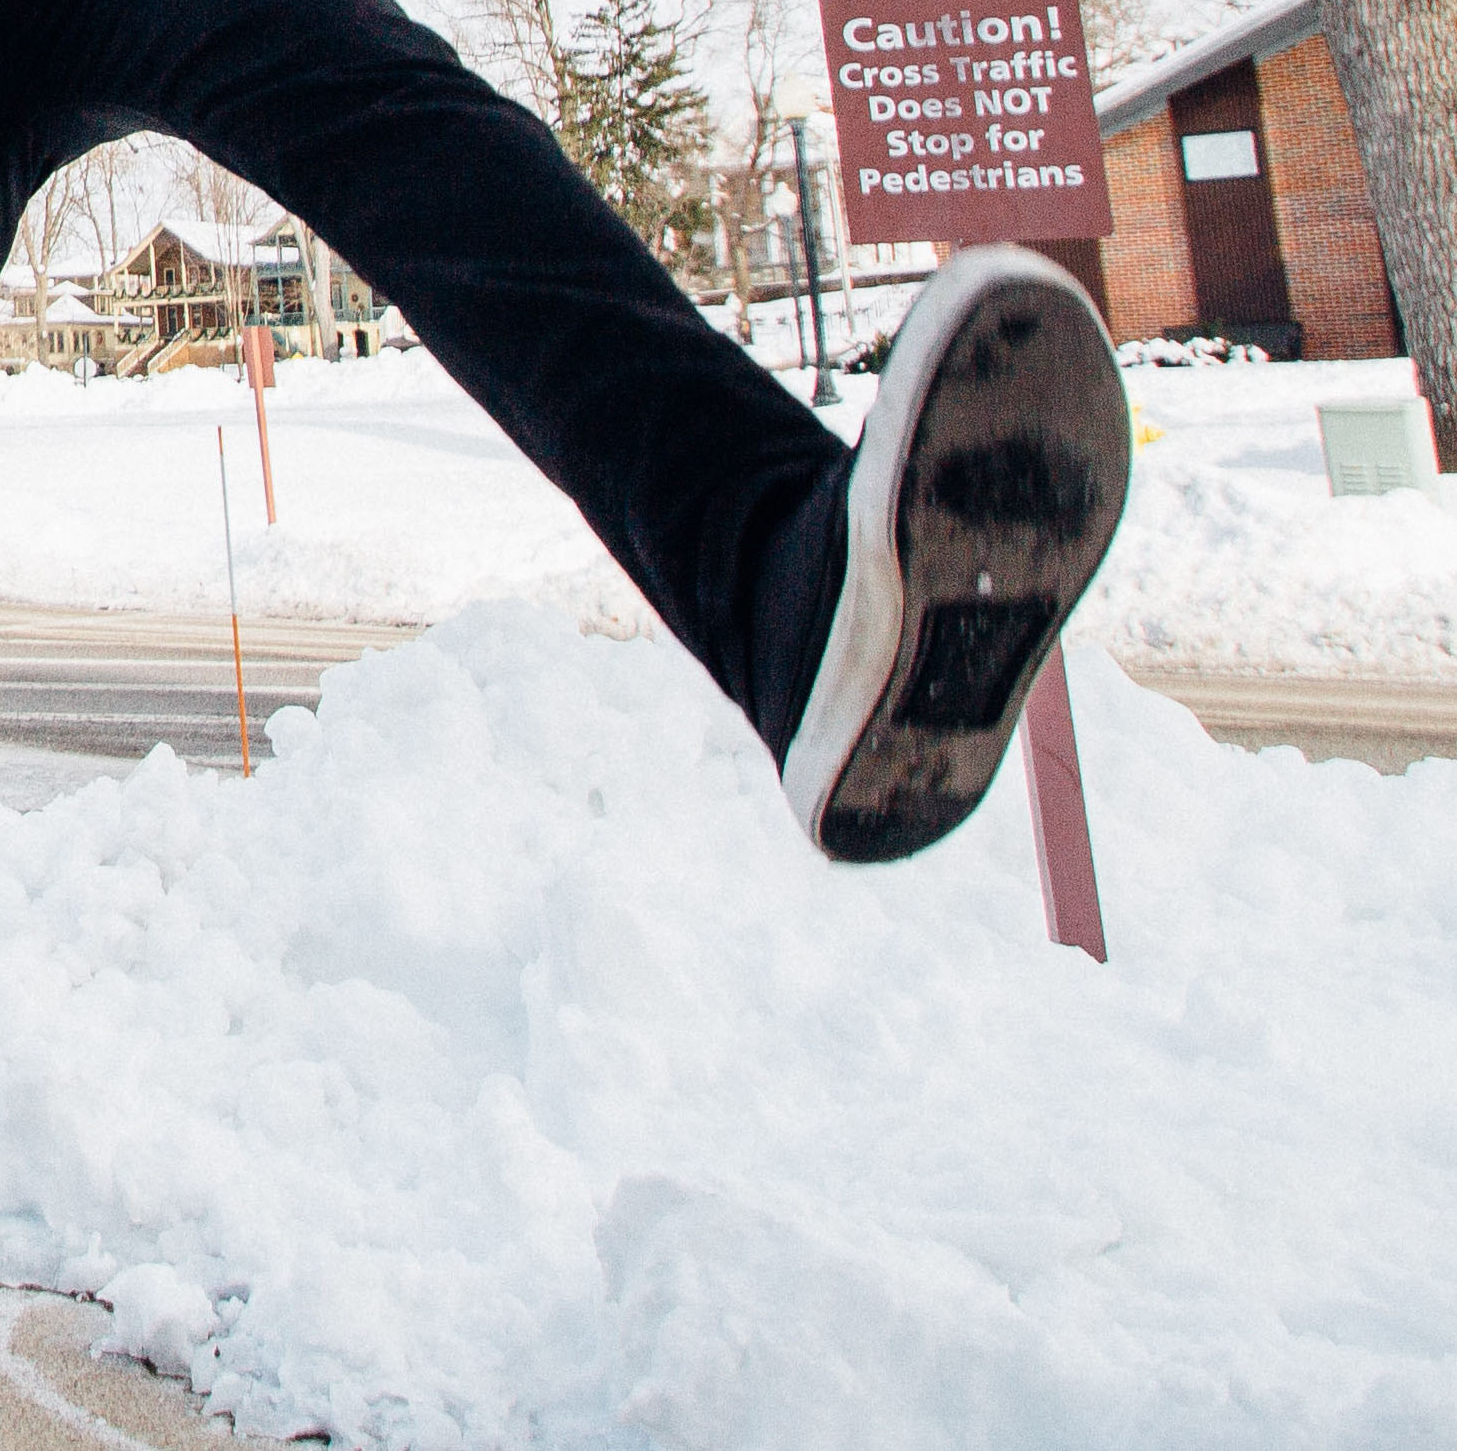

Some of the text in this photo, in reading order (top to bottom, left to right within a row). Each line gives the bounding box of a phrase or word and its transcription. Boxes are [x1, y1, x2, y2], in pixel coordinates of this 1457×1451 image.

[843, 6, 1062, 53] Caution!
[839, 51, 1078, 89] Cross Traffic
[869, 87, 1052, 122] Does NOT
[887, 124, 1045, 160] Stop for
[859, 161, 1084, 194] Pedestrians
